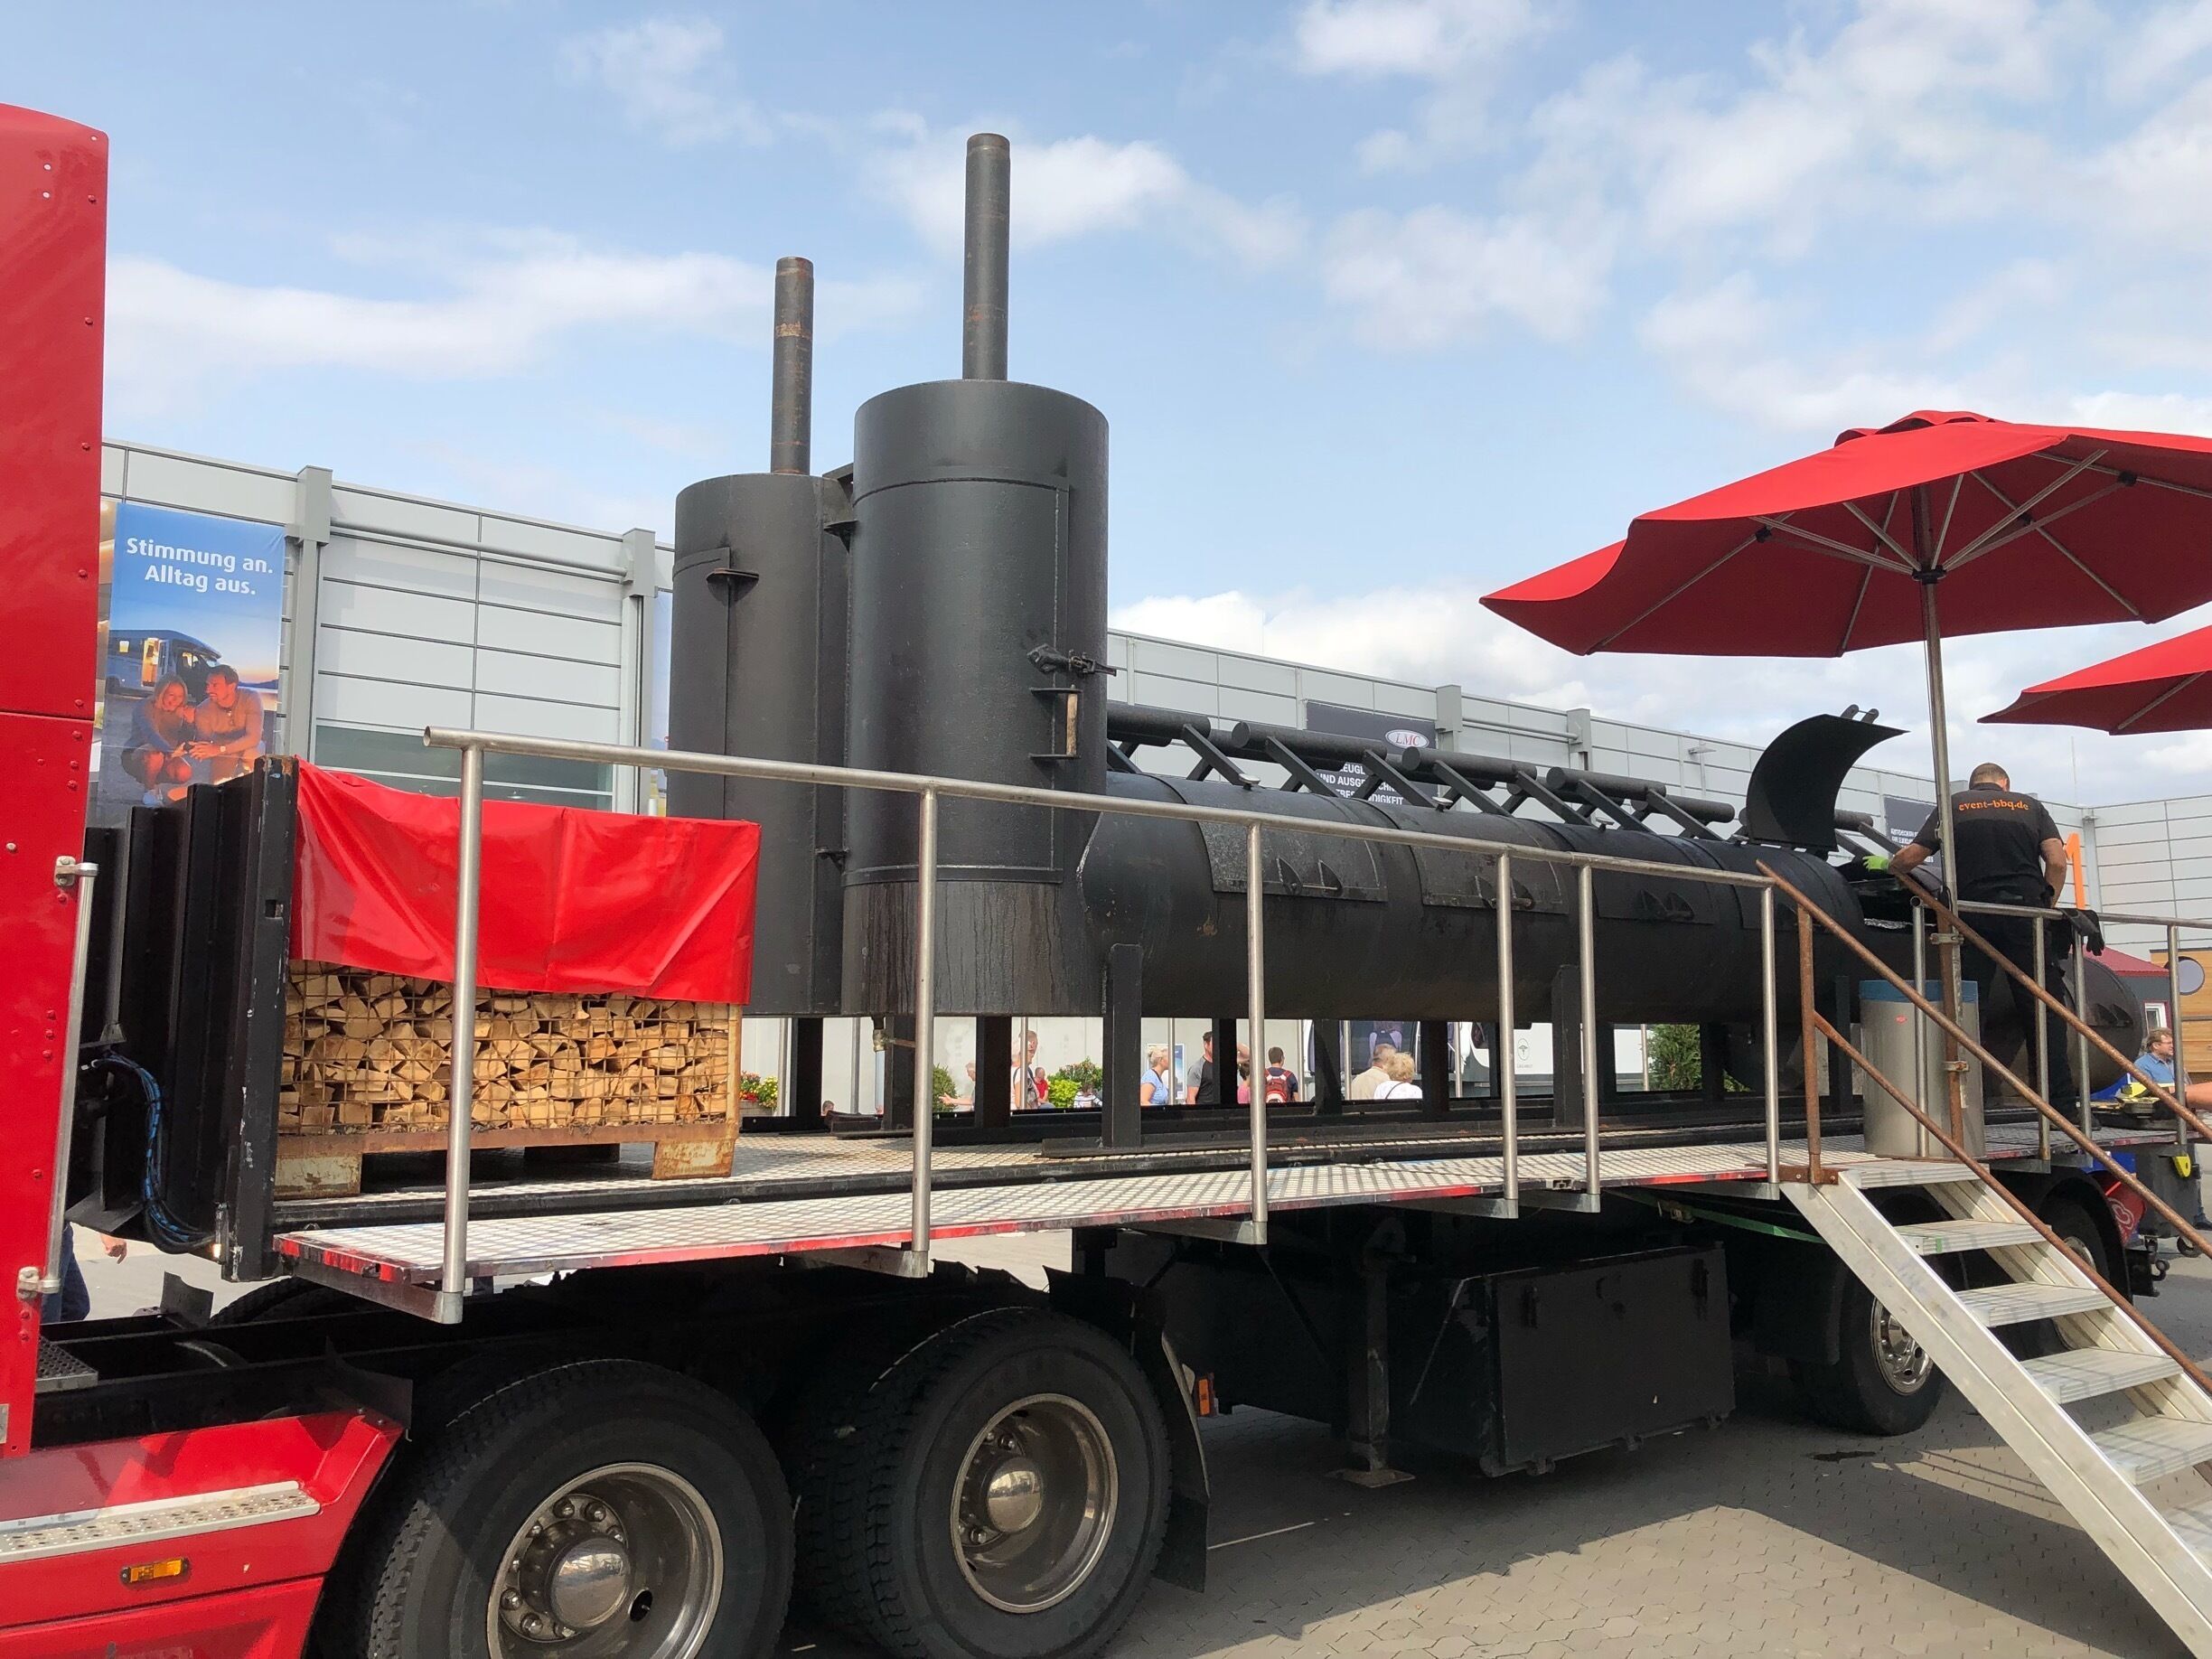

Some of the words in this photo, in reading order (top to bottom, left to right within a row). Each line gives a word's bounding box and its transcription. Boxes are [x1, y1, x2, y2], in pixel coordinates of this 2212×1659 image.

[127, 537, 236, 573] Stimmung
[242, 558, 274, 574] an.
[144, 564, 209, 593] Alltag
[214, 576, 257, 595] aus.
[1395, 732, 1421, 746] LMC
[1958, 799, 2029, 811] event-bbq.de
